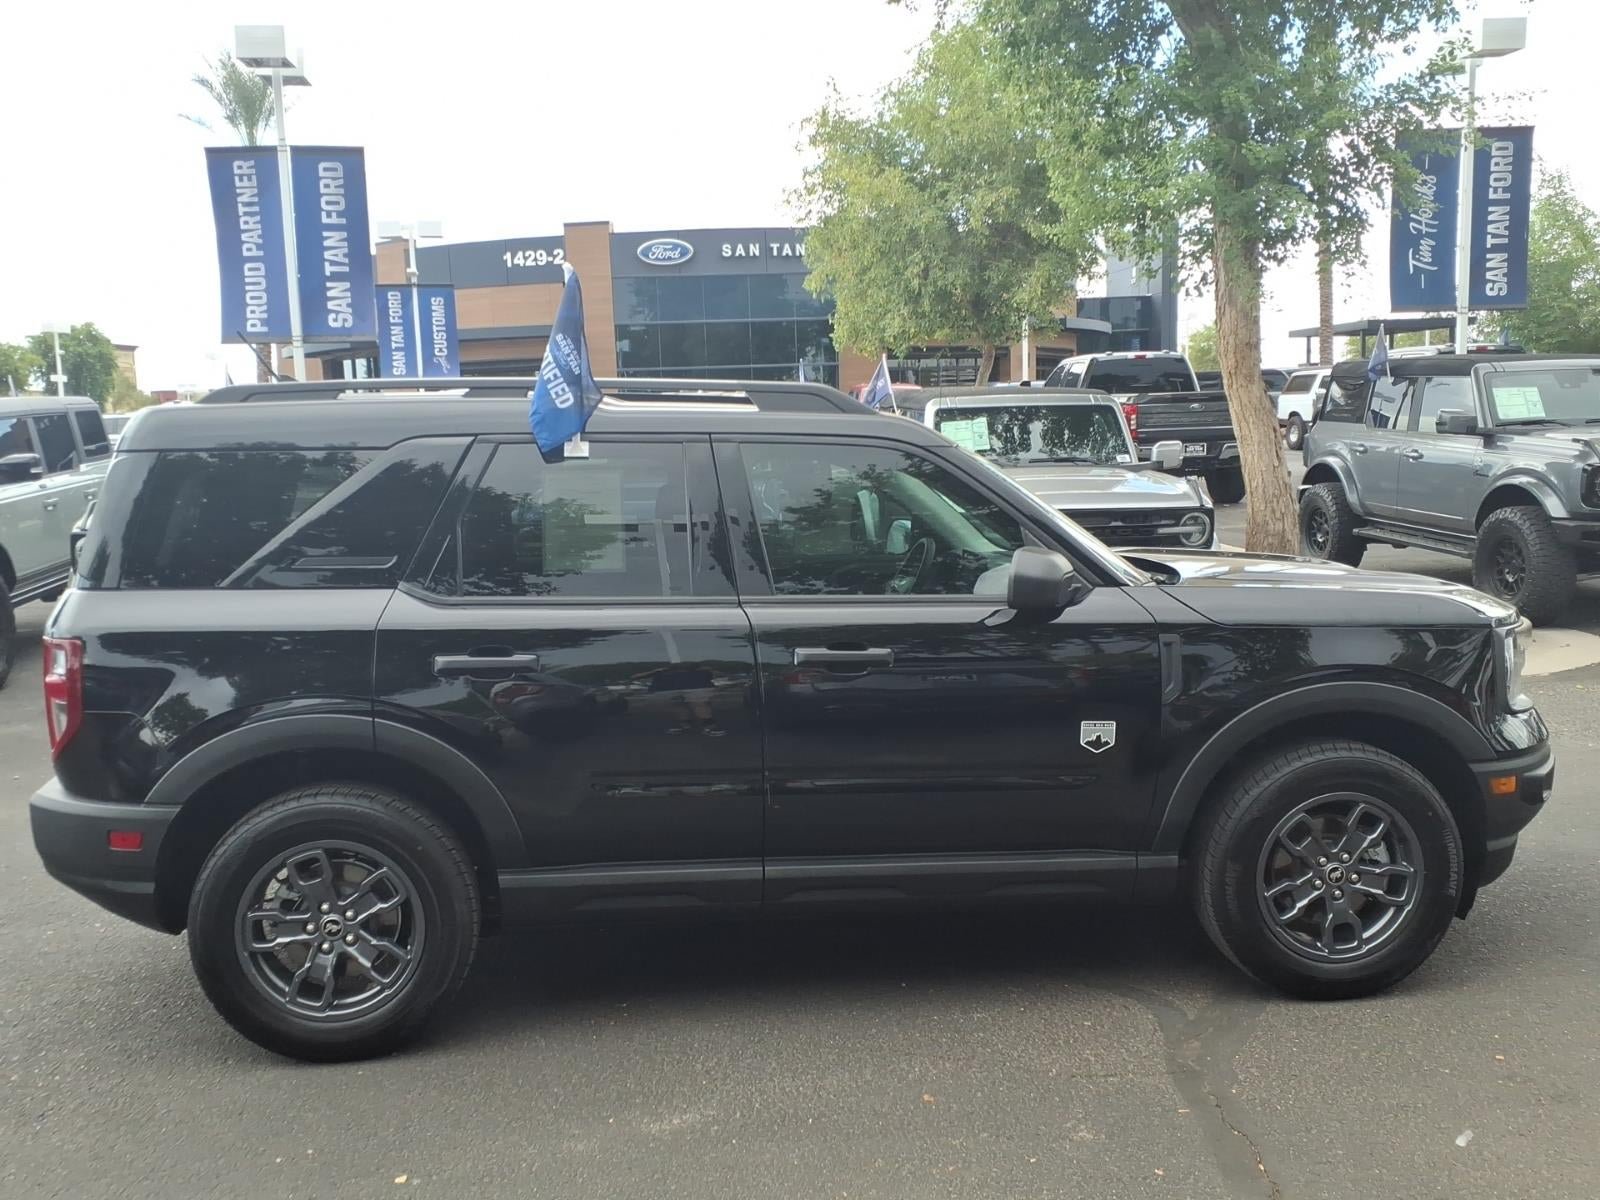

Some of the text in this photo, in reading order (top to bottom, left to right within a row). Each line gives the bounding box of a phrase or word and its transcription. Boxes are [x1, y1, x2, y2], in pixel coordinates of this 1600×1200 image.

[233, 160, 268, 332] PROUD PARTNER
[318, 161, 353, 328] SAN TAN FORD
[1485, 141, 1514, 297] SAN TAN FORD
[648, 244, 682, 260] Ford
[721, 243, 806, 257] SAN TAN
[1408, 237, 1439, 275] Tim
[387, 291, 407, 376] SAN TAN FORD
[430, 296, 448, 356] CUSTOMS
[555, 333, 572, 356] SAN
[567, 353, 581, 376] TAN
